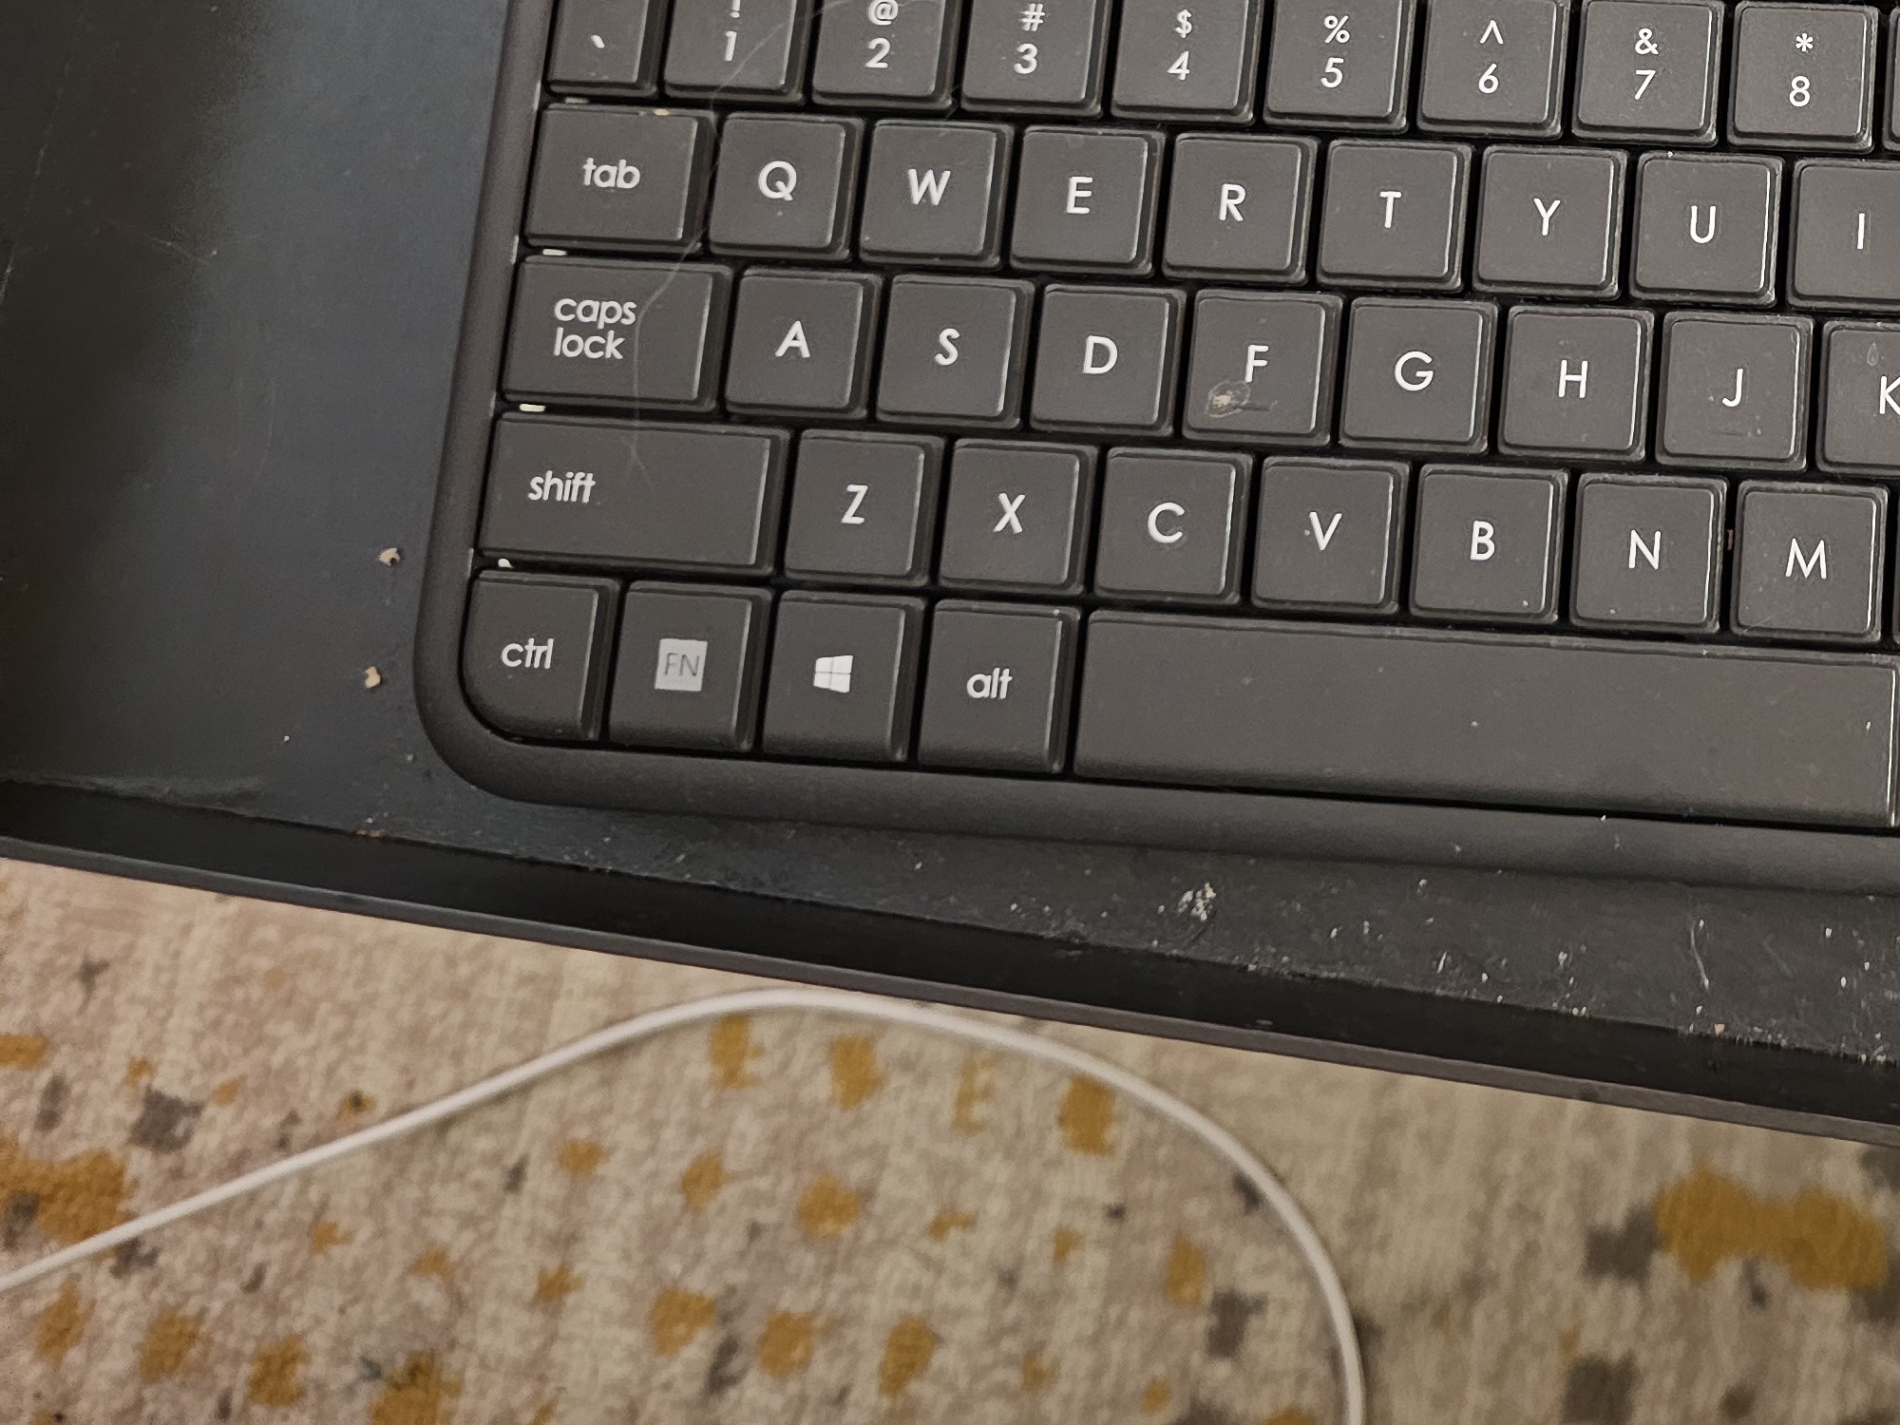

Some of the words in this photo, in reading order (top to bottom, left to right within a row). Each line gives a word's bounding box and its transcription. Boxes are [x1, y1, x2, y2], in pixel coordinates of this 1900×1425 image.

[1020, 3, 1046, 32] #
[1174, 9, 1193, 39] $
[1323, 15, 1350, 44] %
[1479, 19, 1504, 45] ^
[724, 30, 738, 62] 1
[865, 37, 891, 69] 2
[1014, 43, 1038, 75] 3
[1634, 27, 1659, 55] &
[1167, 50, 1190, 81] 4
[1320, 57, 1344, 89] 5
[1478, 63, 1499, 94] 6
[1634, 69, 1656, 100] 7
[1789, 75, 1811, 107] 8
[582, 157, 641, 189] tab
[757, 160, 797, 201] Q
[907, 168, 951, 206] W
[1066, 176, 1093, 215] E
[1219, 183, 1246, 222] R
[1379, 190, 1402, 229] T
[1533, 198, 1561, 236] Y
[1689, 205, 1717, 244] U
[1856, 212, 1866, 250] I
[553, 297, 638, 330] caps
[553, 326, 626, 360] lock
[775, 320, 811, 359] A
[934, 327, 960, 366] S
[1082, 335, 1118, 375] D
[1244, 344, 1269, 383] F
[1394, 350, 1434, 392] G
[1558, 359, 1589, 399] H
[1722, 368, 1744, 408] J
[527, 470, 596, 504] shift
[841, 484, 869, 525] Z
[993, 492, 1026, 534] X
[1147, 502, 1185, 544] C
[1309, 511, 1343, 551] V
[1470, 520, 1495, 561] B
[1628, 529, 1662, 570] N
[1785, 538, 1827, 580] M
[500, 637, 555, 670] ctrl
[662, 651, 701, 677] FN
[966, 667, 1013, 700] alt
